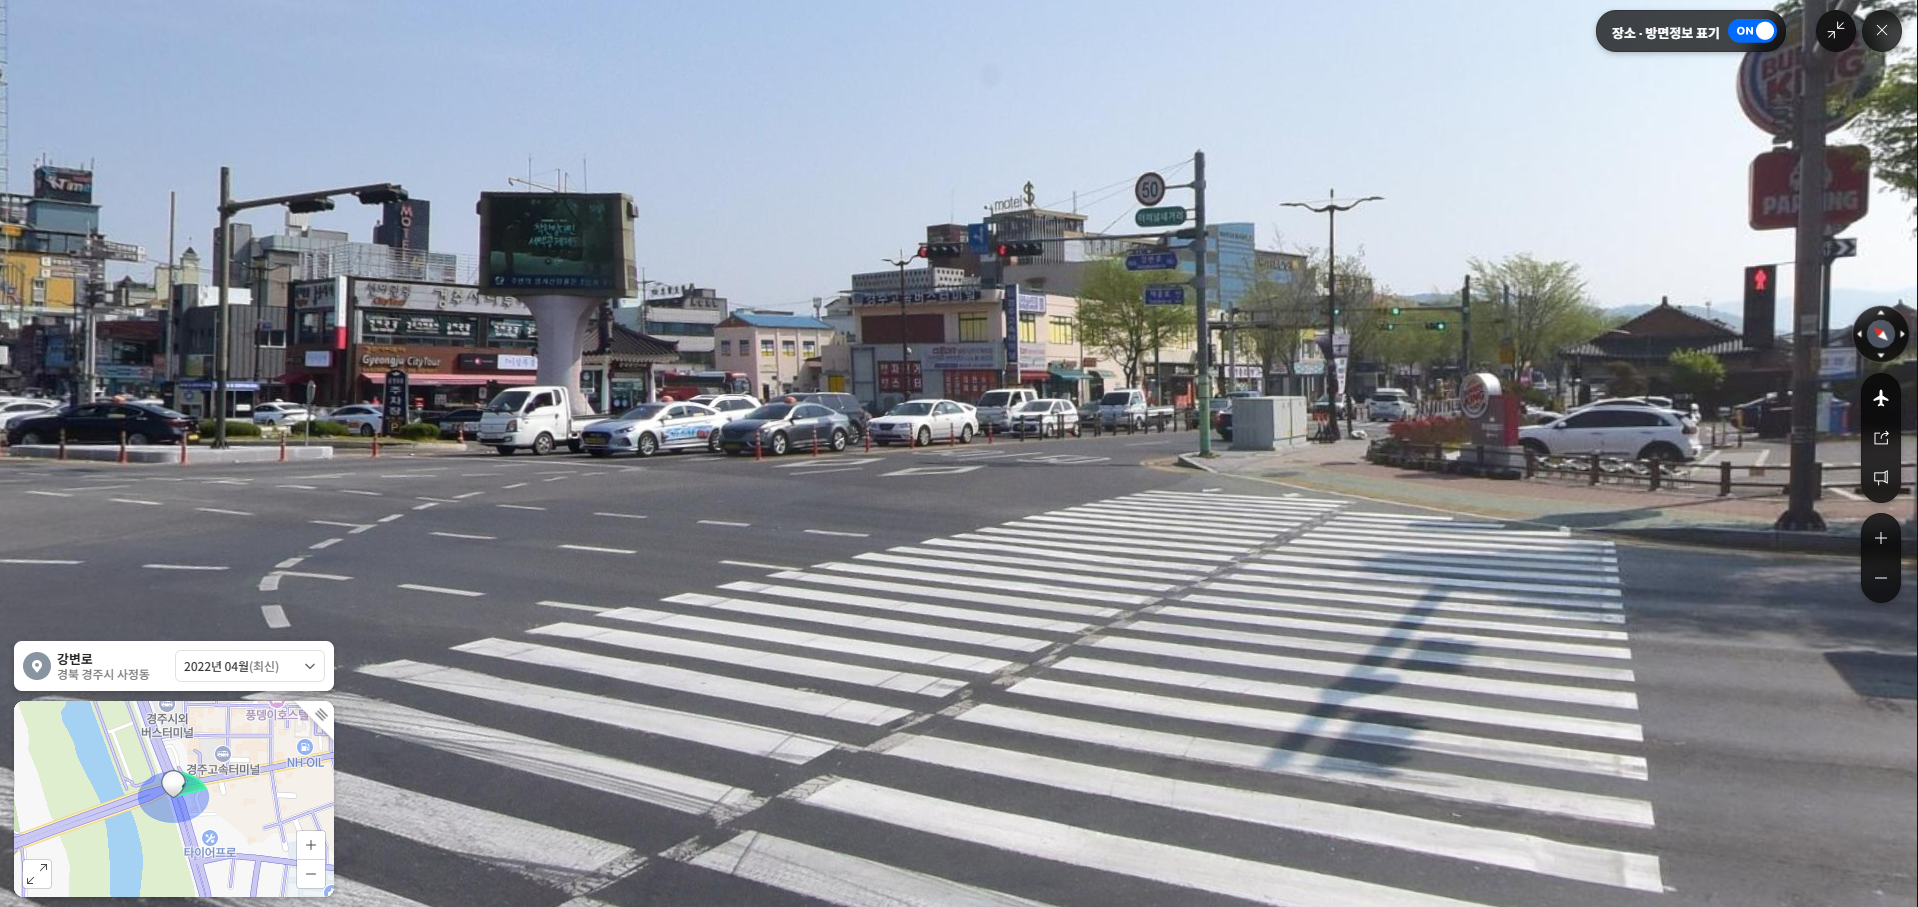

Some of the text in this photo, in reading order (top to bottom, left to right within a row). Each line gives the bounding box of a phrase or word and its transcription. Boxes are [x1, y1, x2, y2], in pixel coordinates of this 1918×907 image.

[1142, 182, 1159, 199] 50
[994, 195, 1022, 211] motel
[1762, 190, 1859, 215] PARING
[362, 354, 405, 368] Gyeongju
